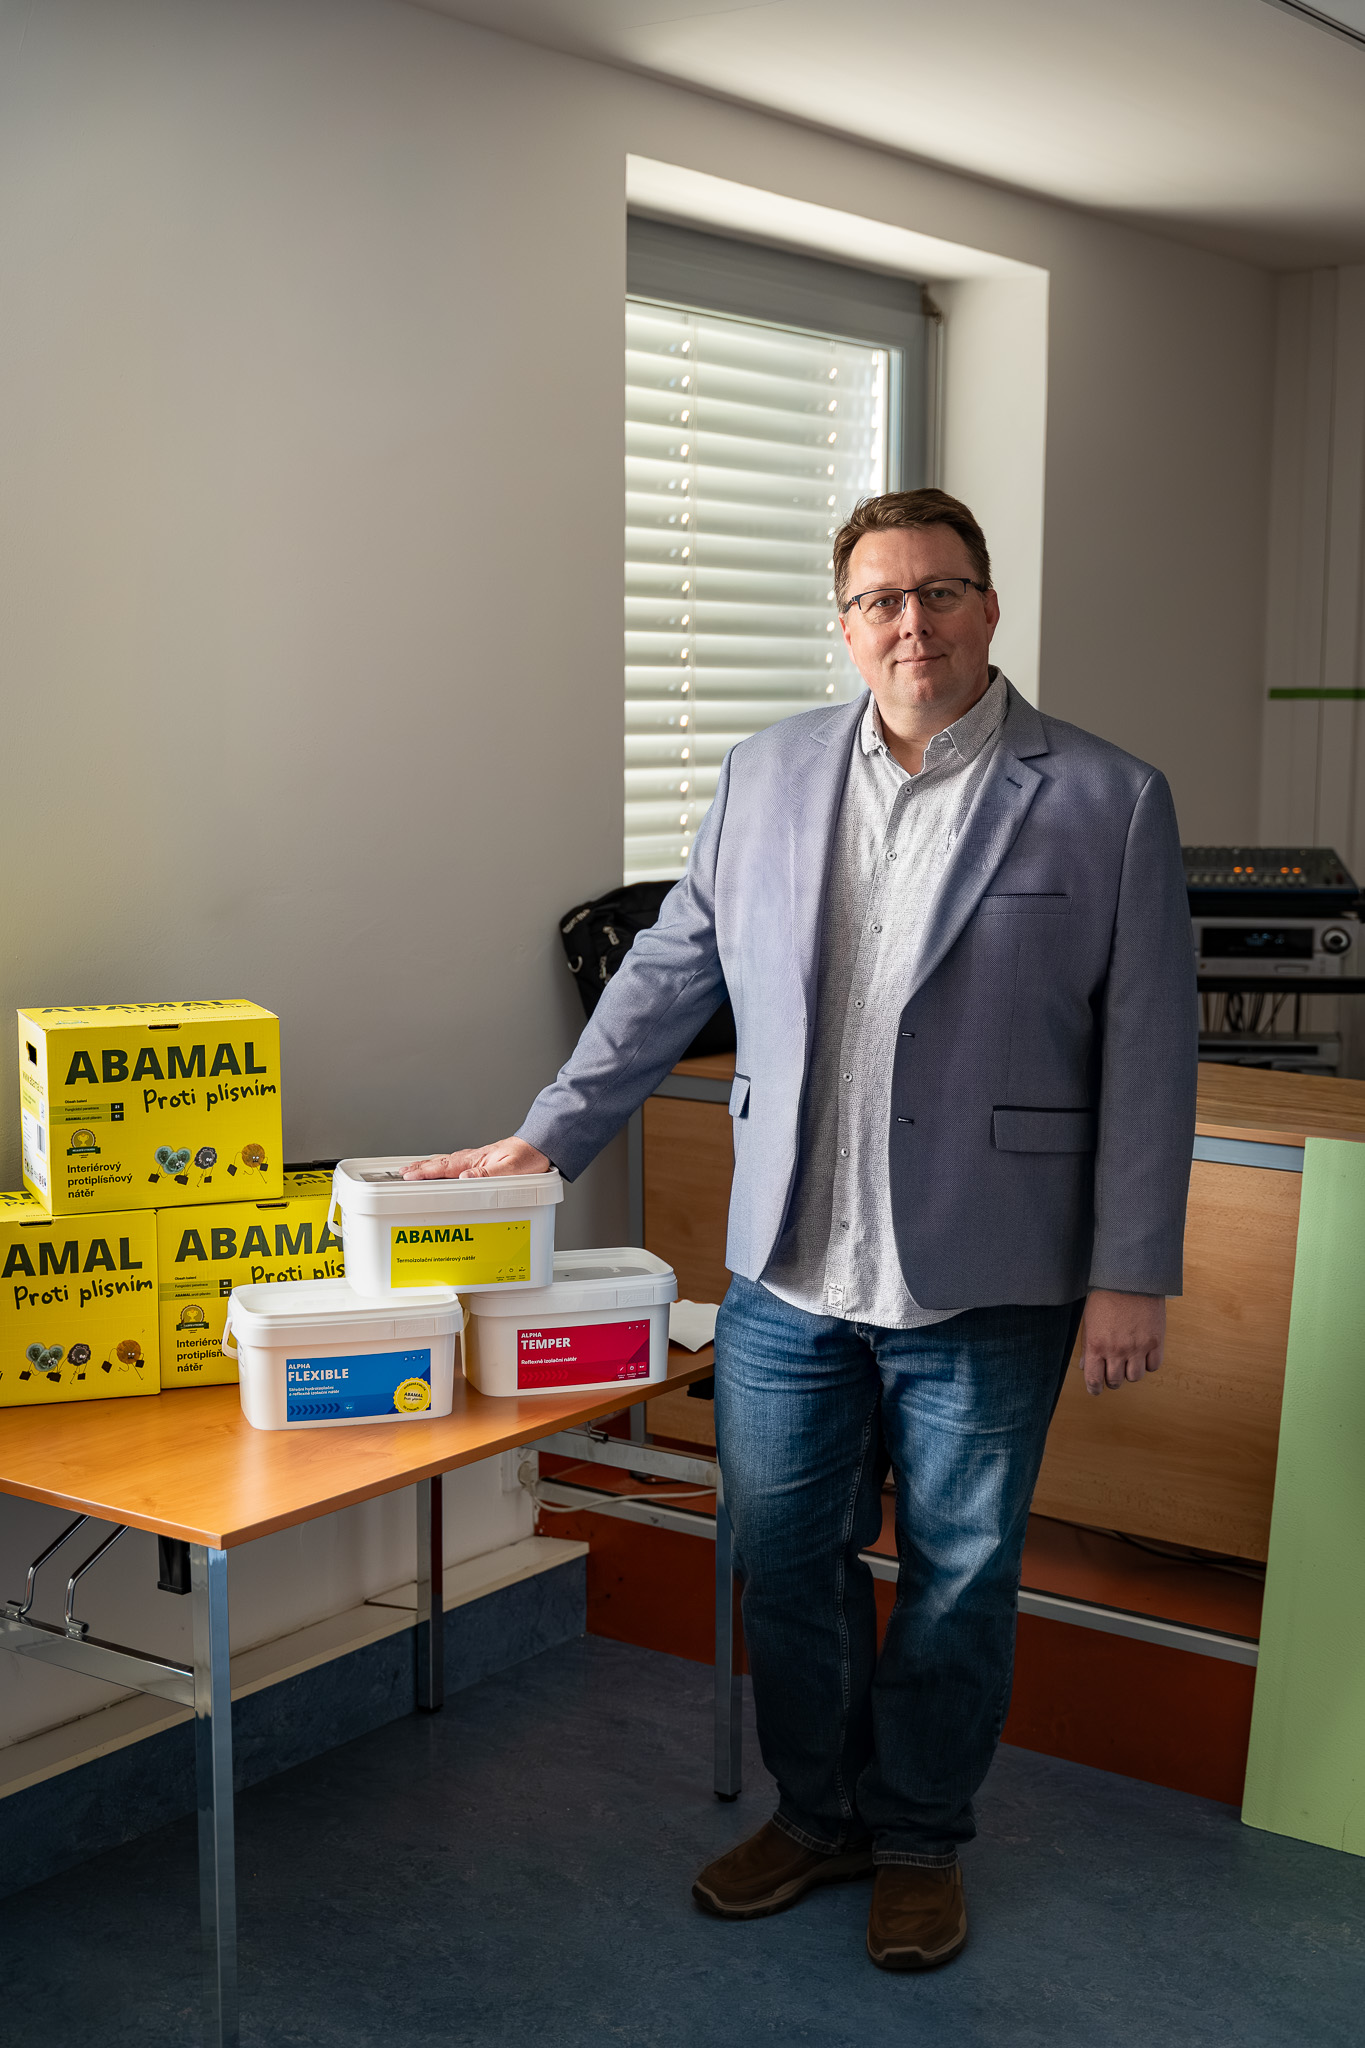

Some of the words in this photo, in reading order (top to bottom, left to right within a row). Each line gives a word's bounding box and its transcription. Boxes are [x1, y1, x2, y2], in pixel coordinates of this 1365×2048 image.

[64, 1041, 267, 1086] ABAMAL
[143, 1088, 196, 1113] Proti
[206, 1079, 277, 1111] plísním
[67, 1161, 122, 1173] Interiérový
[67, 1173, 133, 1188] protiplísňový
[68, 1188, 95, 1198] nátěr
[395, 1227, 474, 1244] ABAMAL
[1, 1237, 143, 1278] AMAL
[251, 1265, 302, 1284] Proti
[14, 1284, 69, 1310] Proti
[79, 1275, 153, 1308] plísním
[176, 1337, 226, 1349] Interiérov
[521, 1337, 571, 1350] TEMPER
[177, 1362, 203, 1373] nátěr
[288, 1368, 349, 1382] FLEXIBLE
